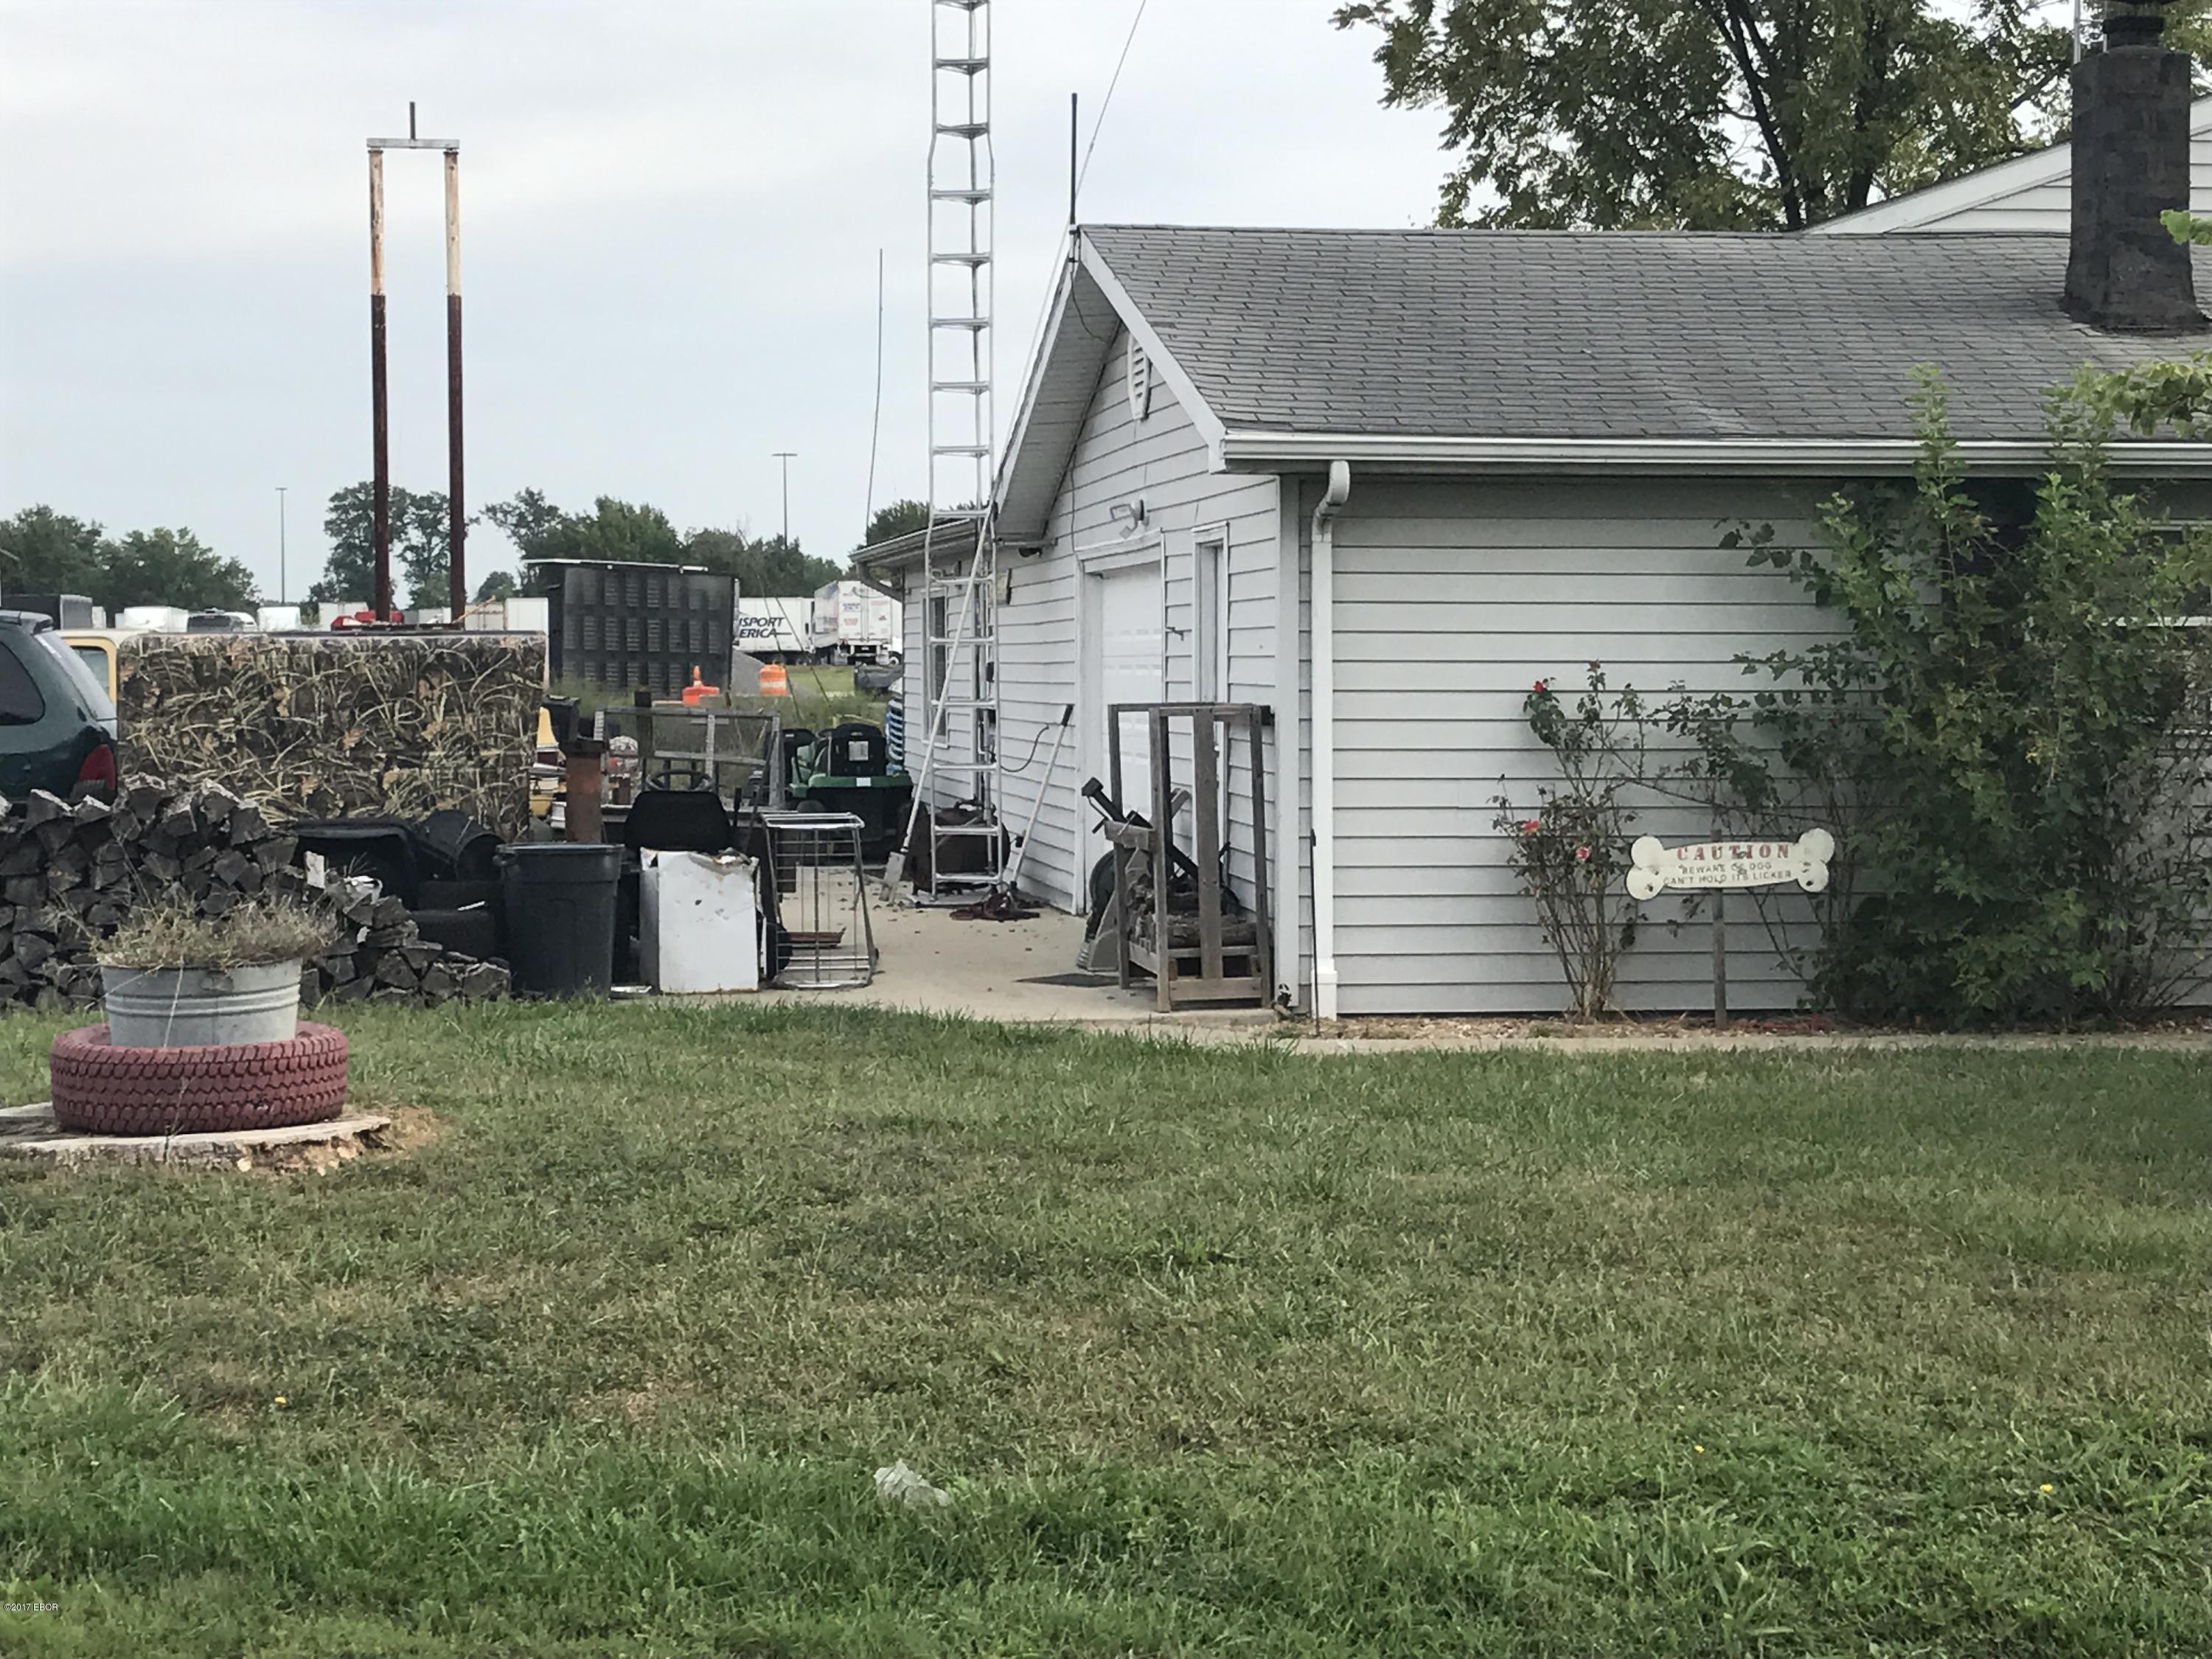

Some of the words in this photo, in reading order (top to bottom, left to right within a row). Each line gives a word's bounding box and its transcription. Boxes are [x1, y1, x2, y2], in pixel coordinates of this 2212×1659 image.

[1677, 844, 1789, 861] CAUTION
[1749, 862, 1772, 870] DOG
[1663, 876, 1694, 885] CAN'T
[1699, 874, 1727, 883] HOLD
[1753, 870, 1791, 880] LICKER
